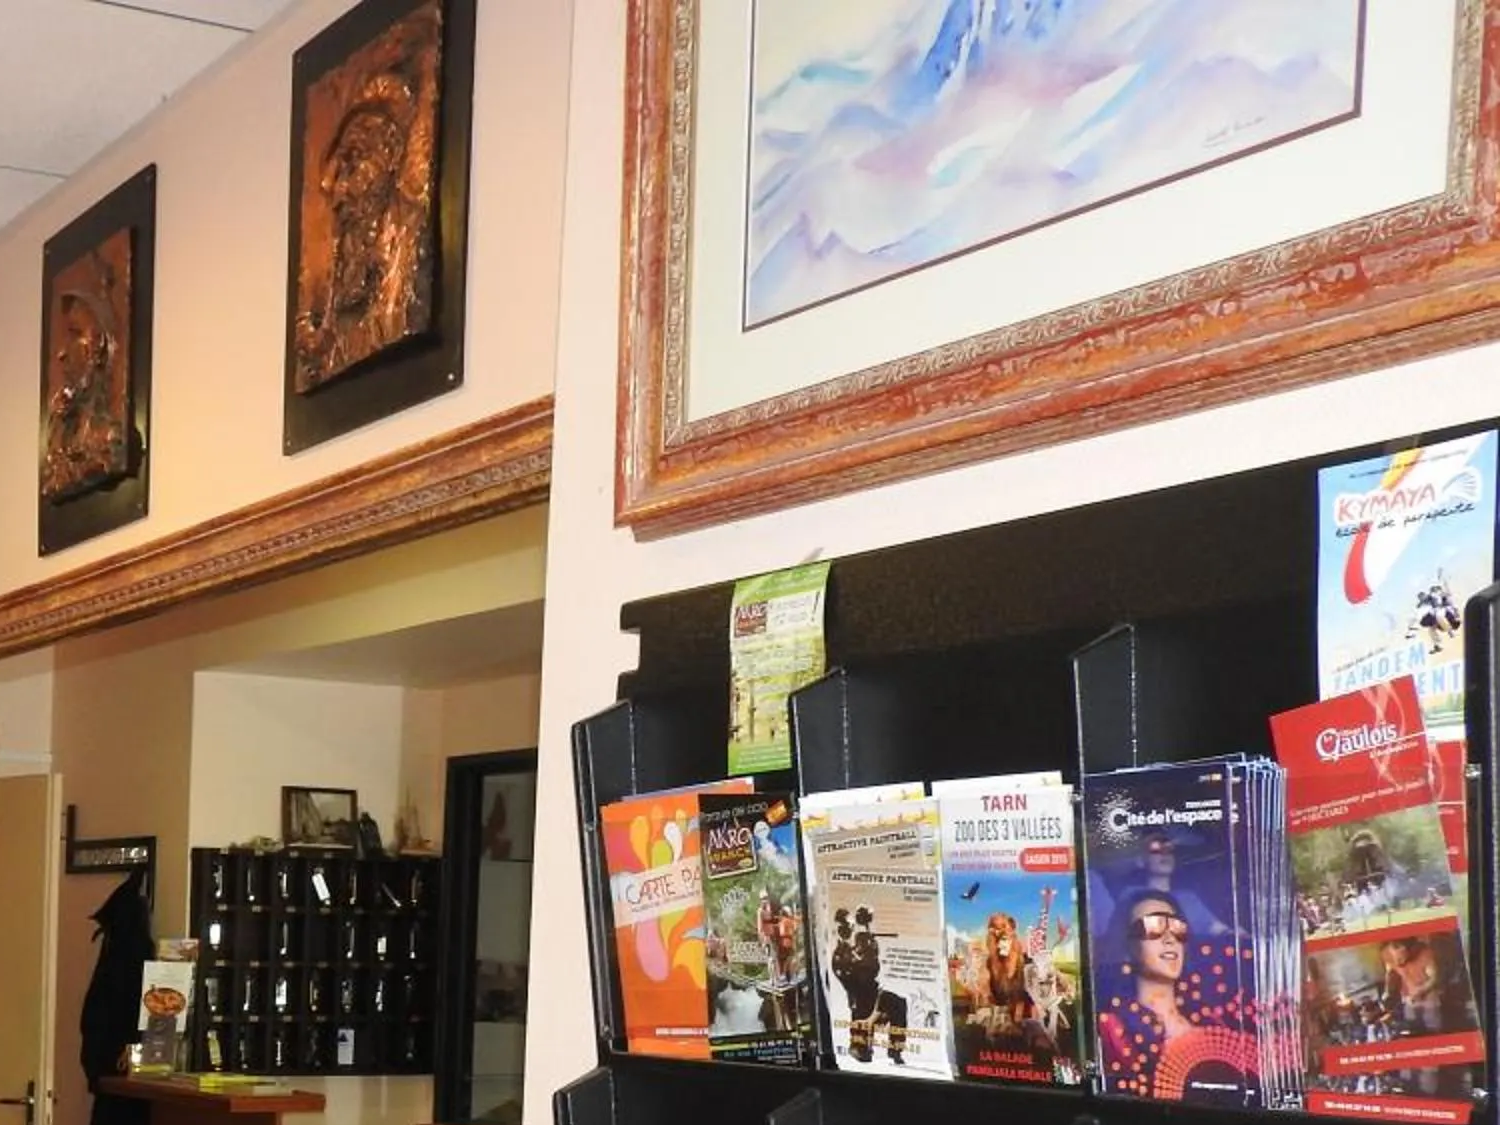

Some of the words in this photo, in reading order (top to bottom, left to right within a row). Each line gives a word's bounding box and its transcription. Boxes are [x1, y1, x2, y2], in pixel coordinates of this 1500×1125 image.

[1338, 483, 1436, 522] KYMAYA
[1332, 643, 1426, 692] TANDEM
[981, 794, 1028, 812] TARN
[1147, 812, 1164, 825] de
[1165, 808, 1223, 827] l'espace
[708, 822, 752, 851] AKRO
[817, 835, 868, 854] ATTRACTIVE
[869, 830, 917, 848] PAINTBALL
[954, 820, 975, 843] ZOO
[978, 818, 999, 841] DES
[1001, 818, 1009, 841] 3
[624, 873, 676, 905] CARTE
[831, 871, 884, 883] ATTRACTIVE
[885, 874, 936, 886] PAINTBALL
